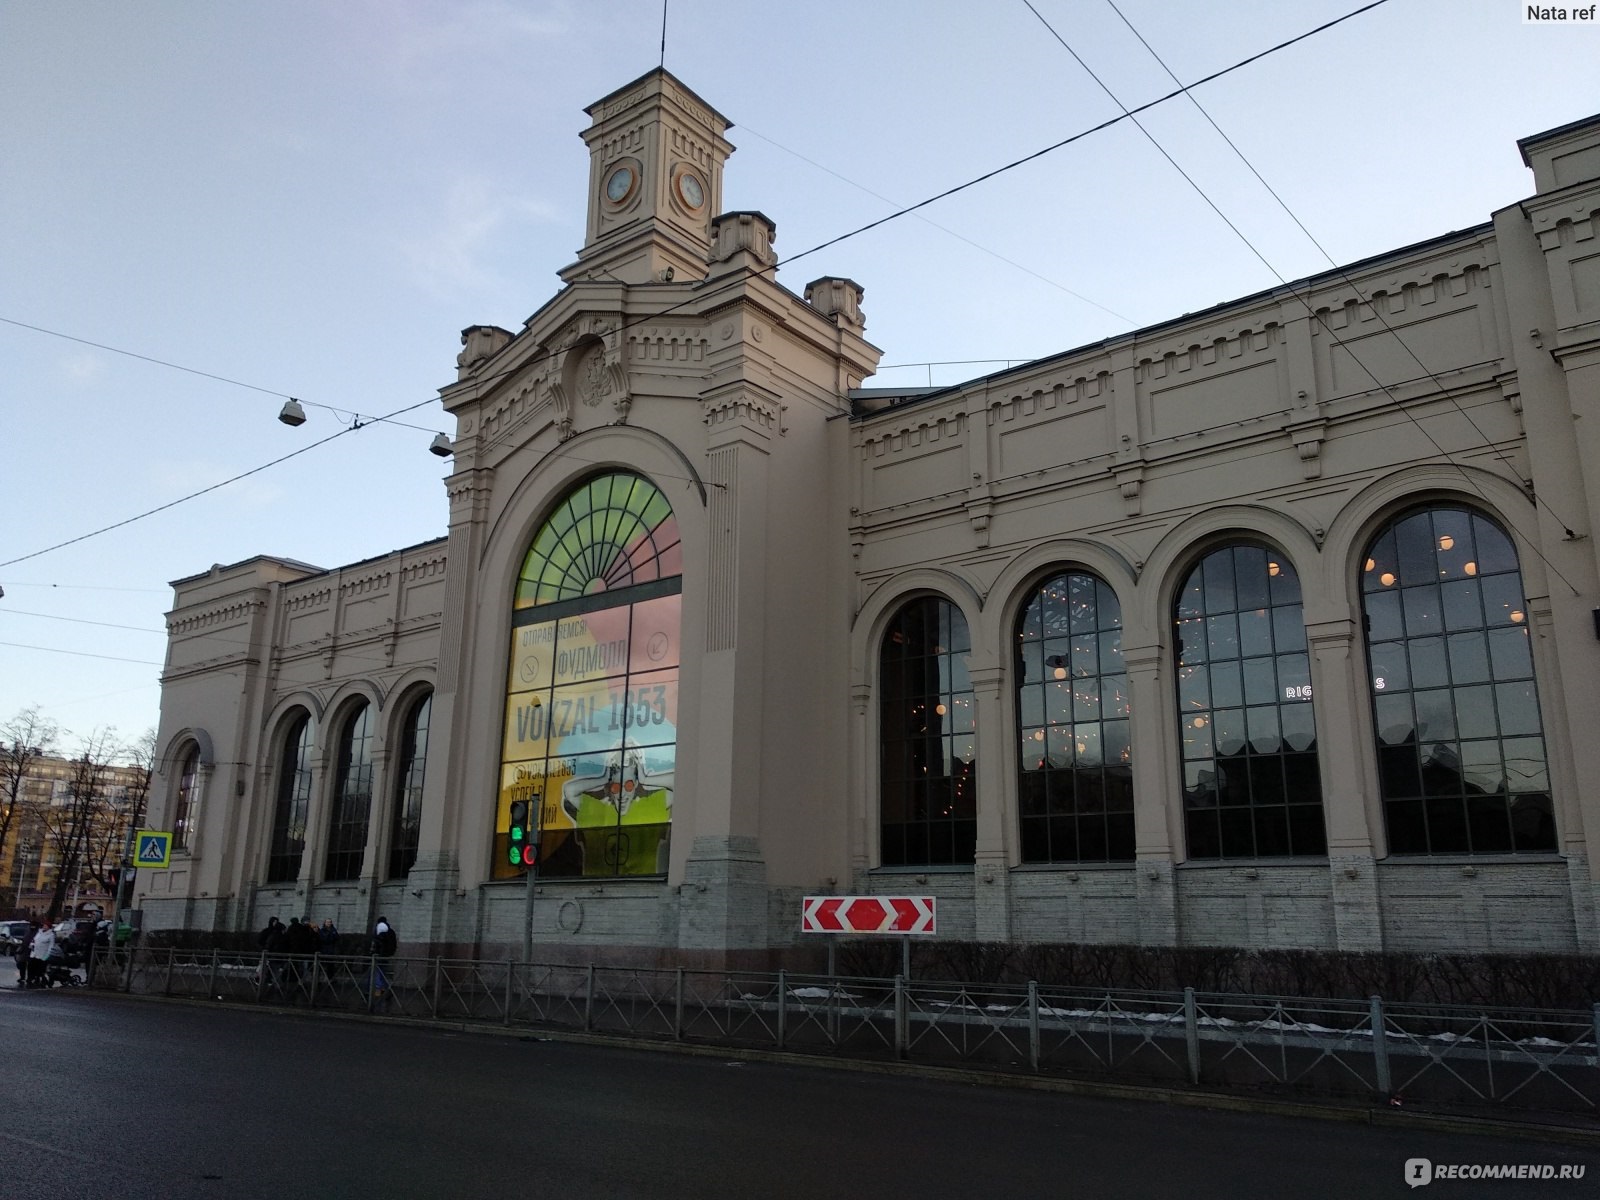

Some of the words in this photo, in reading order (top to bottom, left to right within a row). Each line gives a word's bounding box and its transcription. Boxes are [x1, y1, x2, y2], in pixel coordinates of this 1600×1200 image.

[557, 639, 627, 680] ФУДМОЛЛ
[517, 695, 600, 743] VOKZAL
[608, 685, 666, 731] 1853
